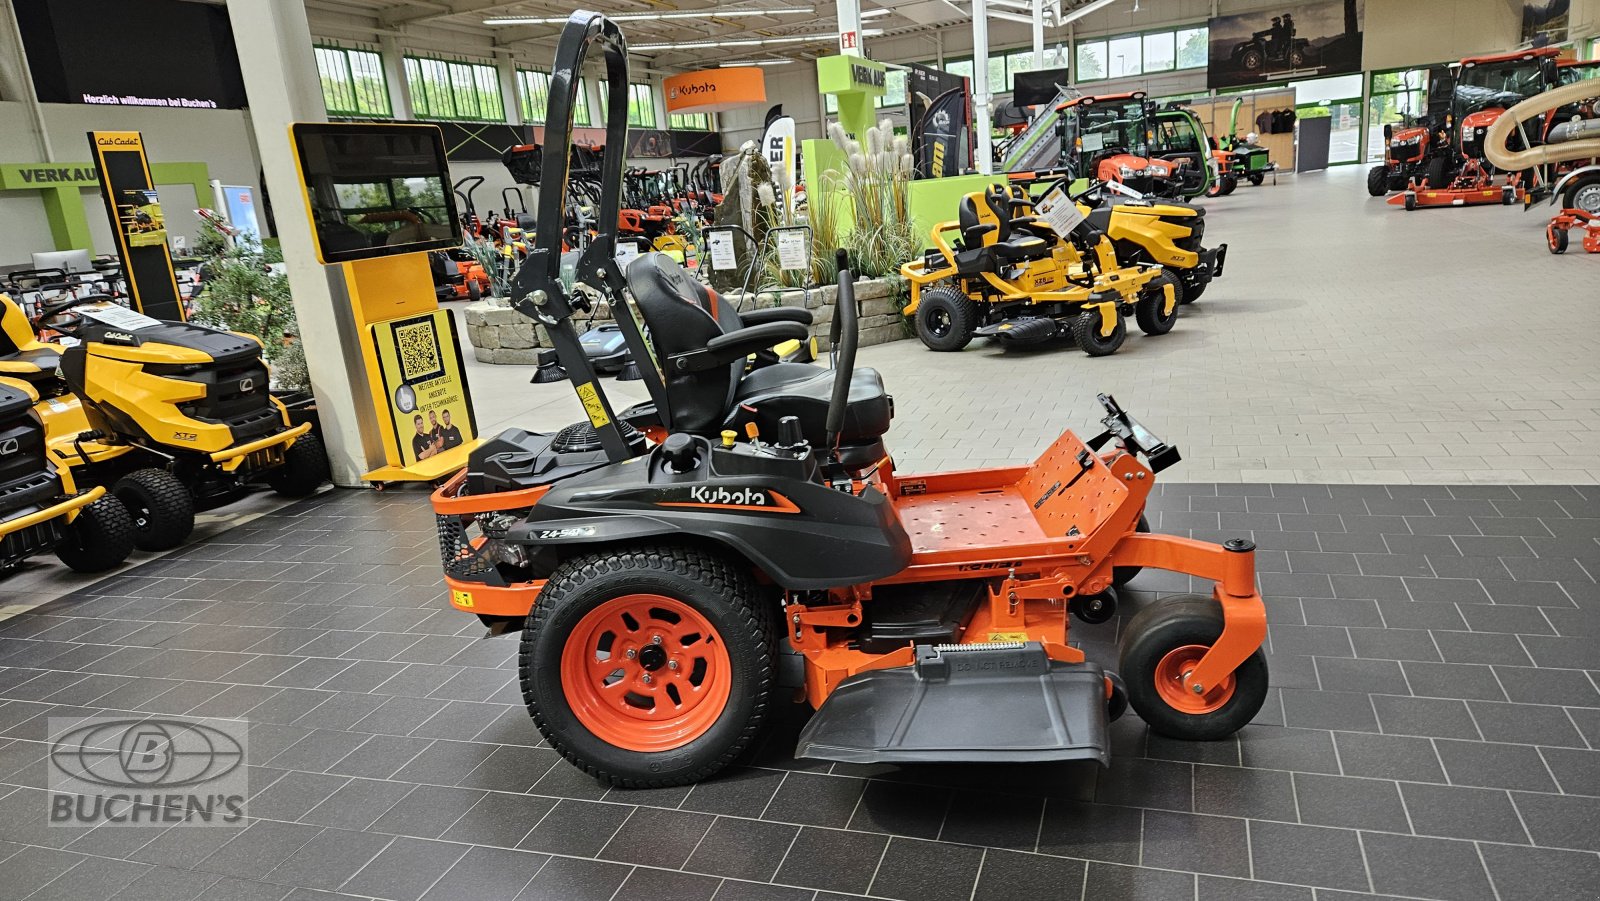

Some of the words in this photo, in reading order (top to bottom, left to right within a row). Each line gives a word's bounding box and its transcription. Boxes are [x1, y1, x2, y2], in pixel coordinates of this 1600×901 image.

[680, 82, 716, 95] Kubota
[82, 93, 119, 104] Herzlich
[120, 95, 168, 106] willkommen
[168, 97, 181, 107] bei
[182, 98, 216, 109] Buchen's
[19, 168, 97, 183] VERKAU
[690, 486, 765, 505] Kubota
